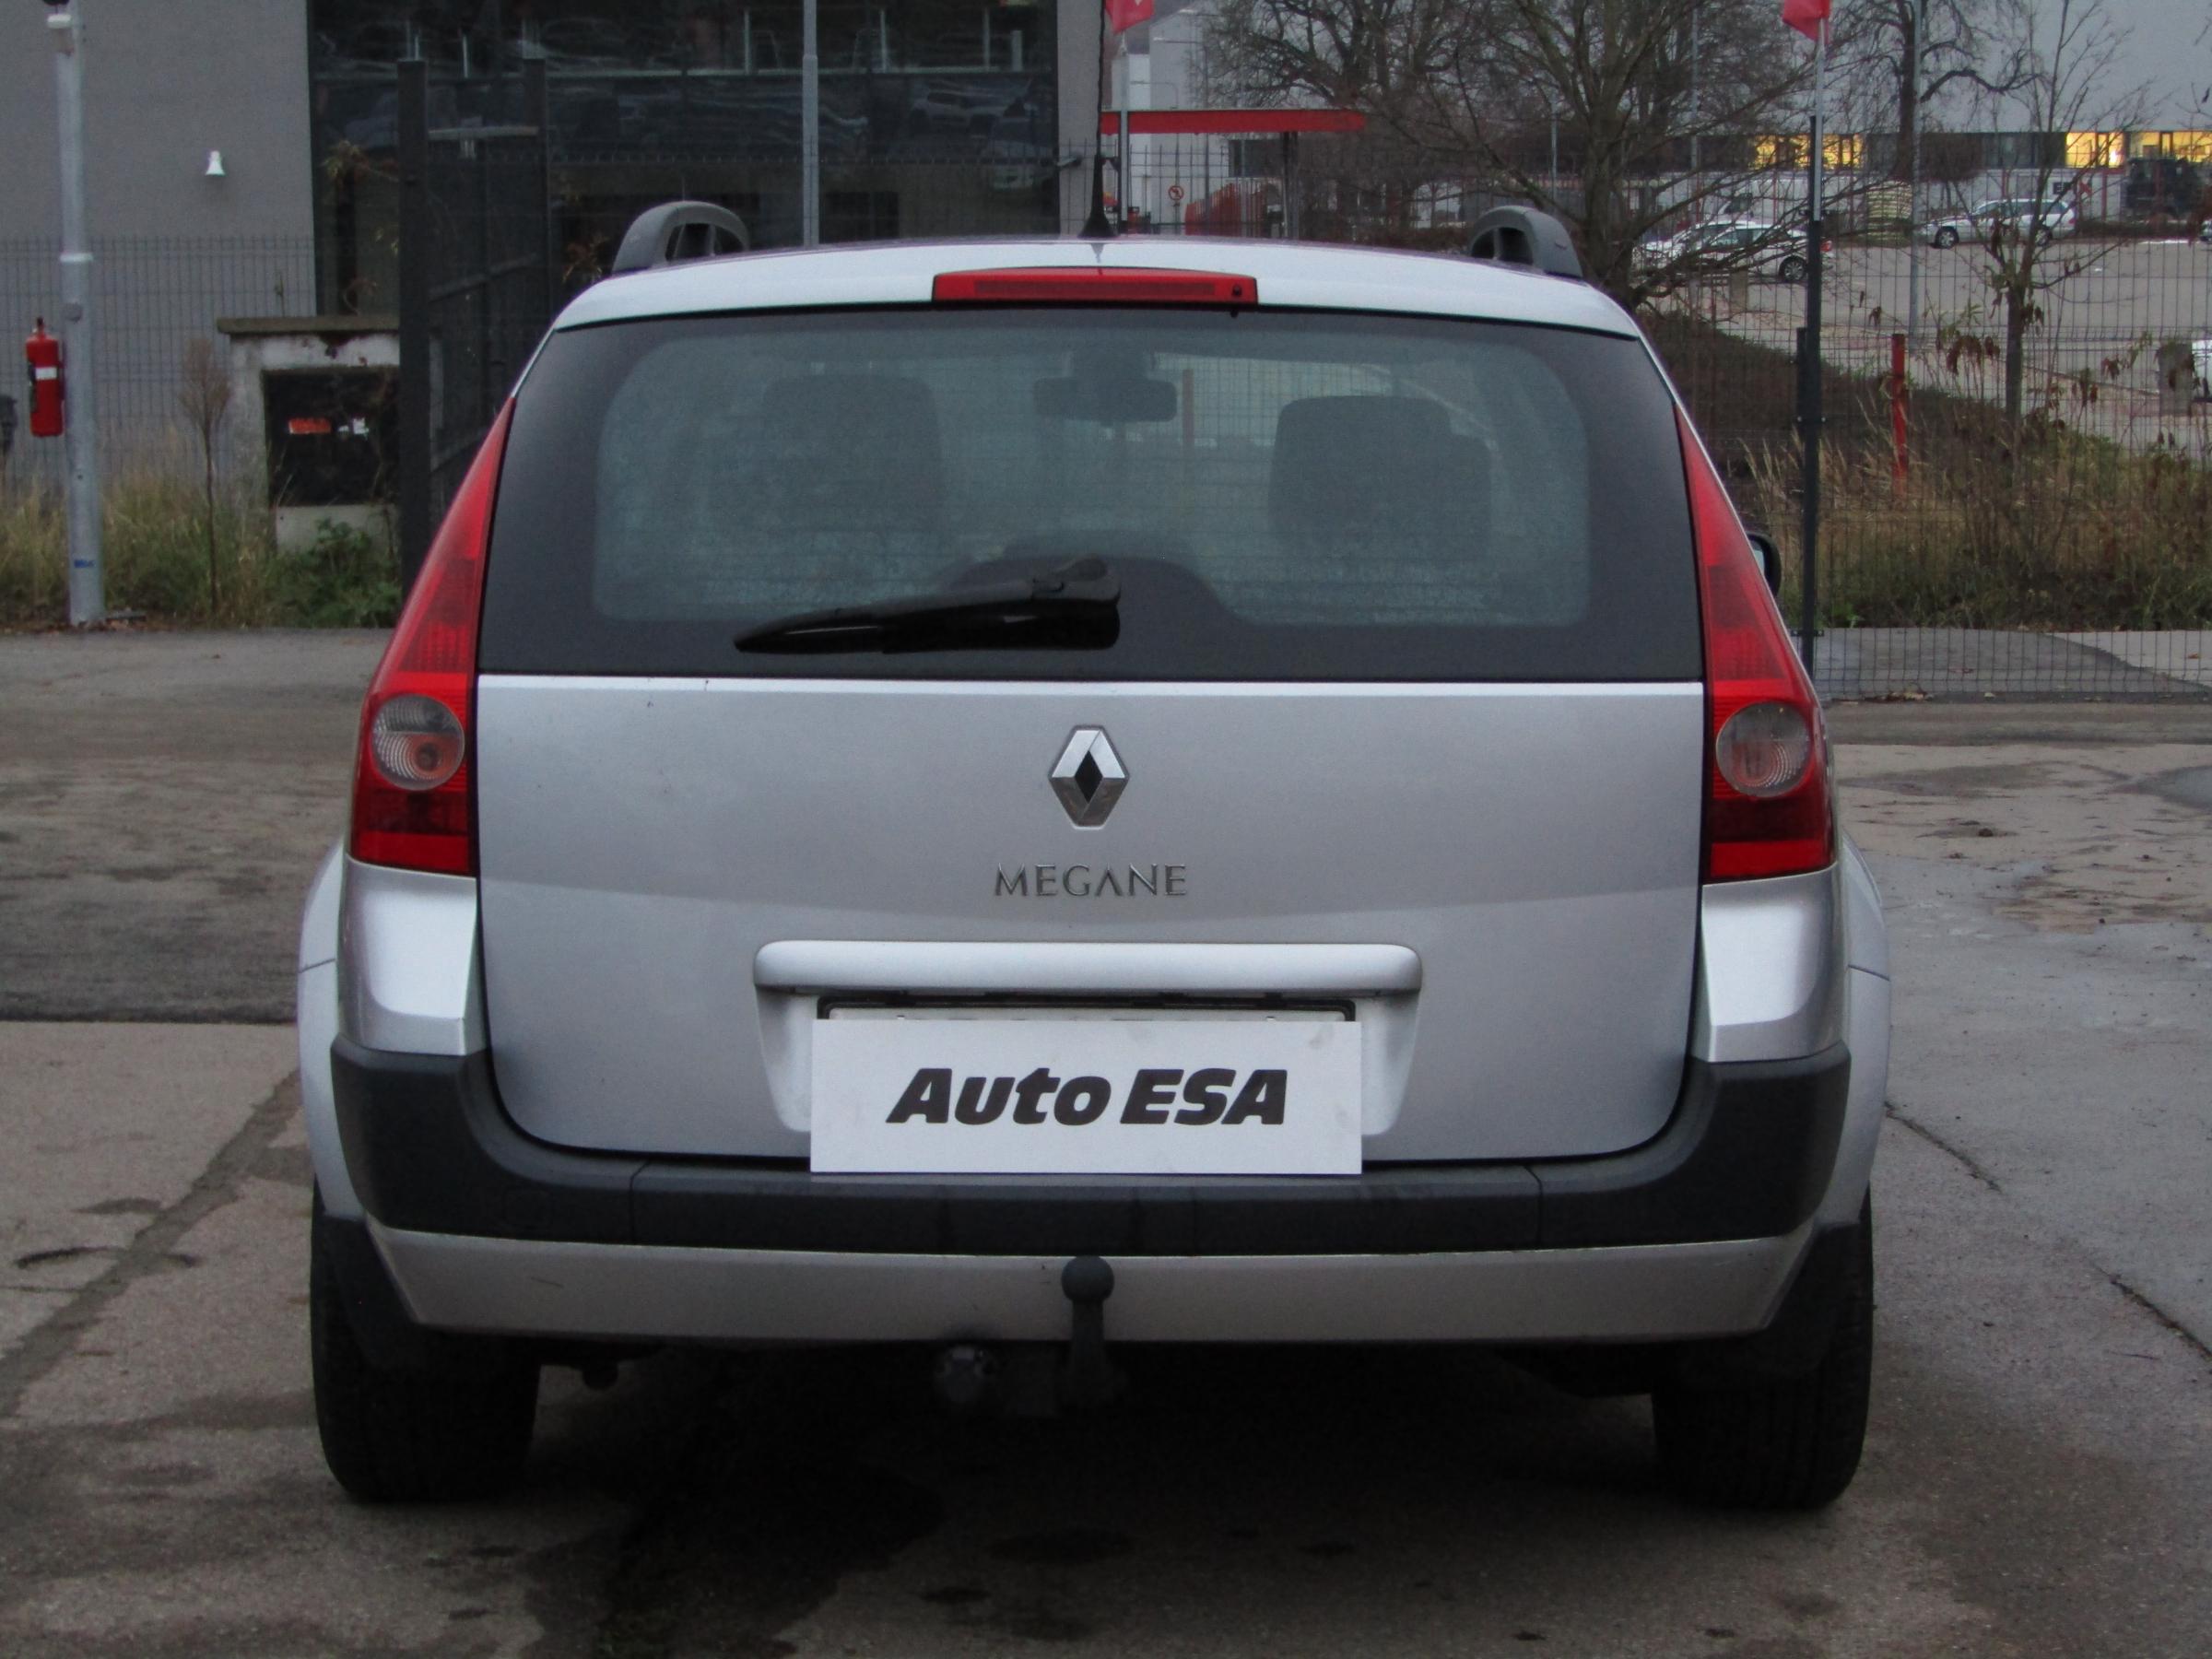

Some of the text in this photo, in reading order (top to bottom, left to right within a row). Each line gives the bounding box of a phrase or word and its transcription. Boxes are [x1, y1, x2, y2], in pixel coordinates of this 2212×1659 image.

[994, 863, 1187, 897] MEGANE
[885, 1067, 1288, 1126] Auto ESA
